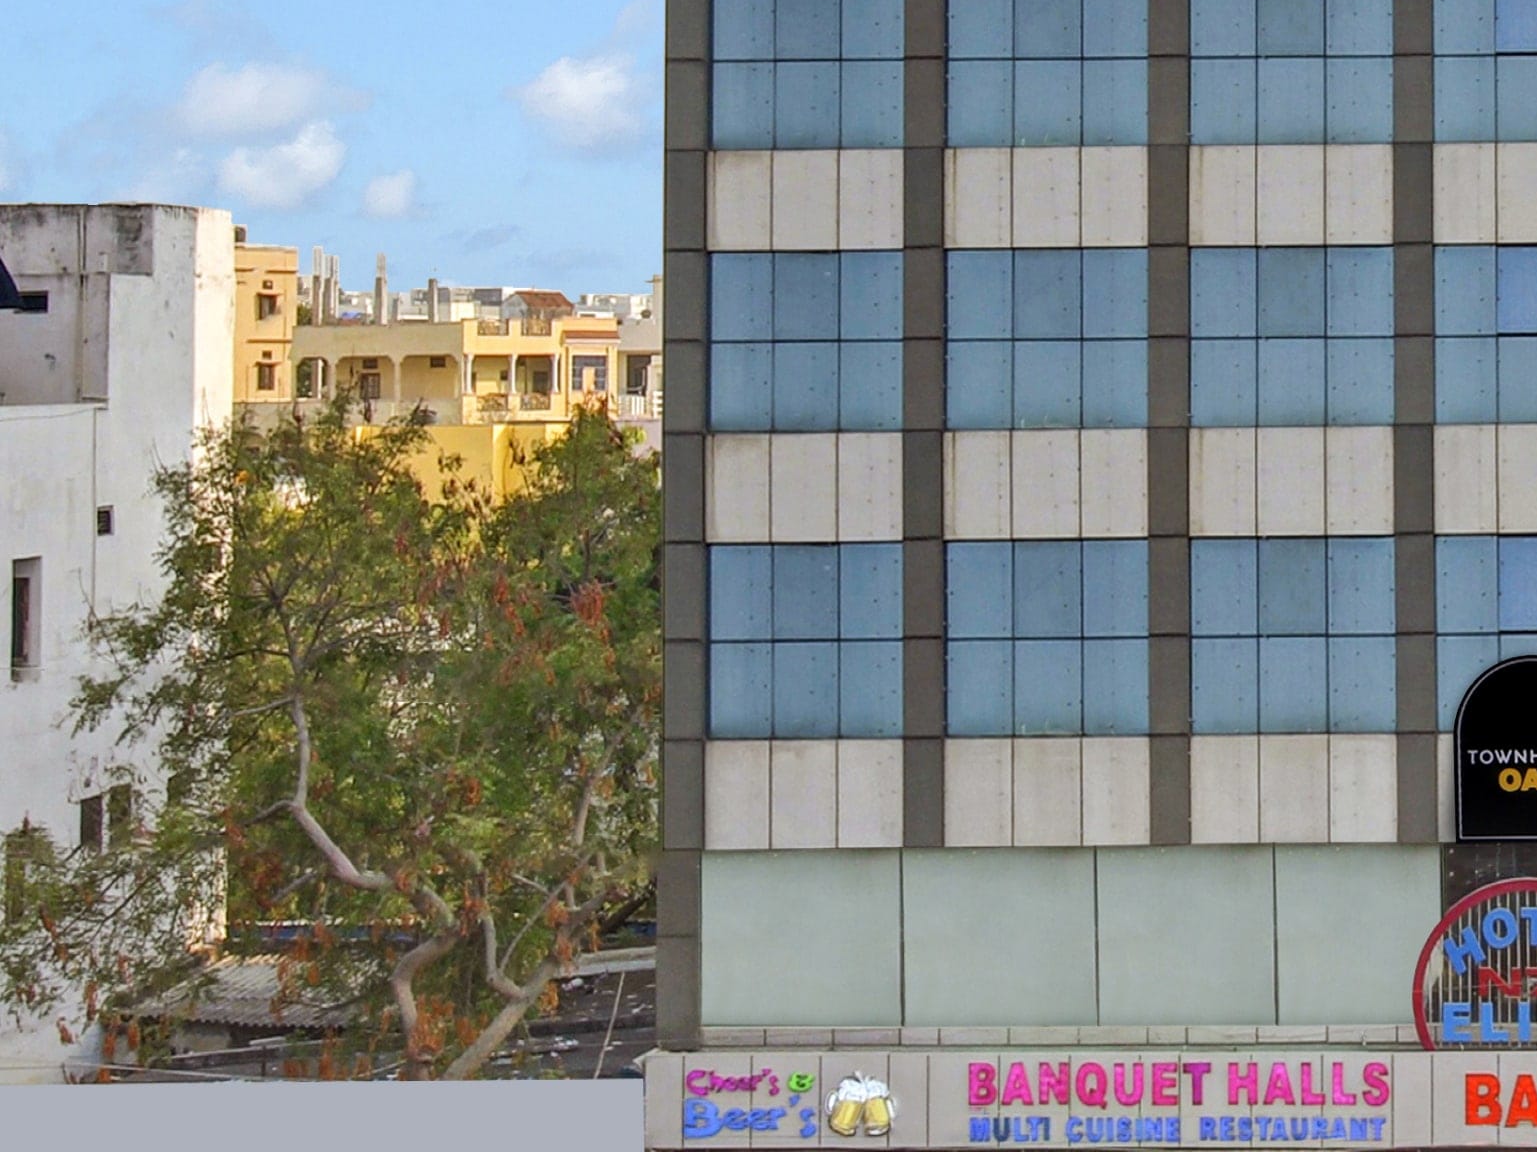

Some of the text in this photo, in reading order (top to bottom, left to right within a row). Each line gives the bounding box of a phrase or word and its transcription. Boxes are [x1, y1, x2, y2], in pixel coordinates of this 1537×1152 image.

[685, 1068, 781, 1097] Cheer's
[967, 1061, 1391, 1109] BANQUET HALLS
[682, 1094, 817, 1139] Beer's
[968, 1115, 1388, 1144] MULTI CUISINE RESTAURANT
